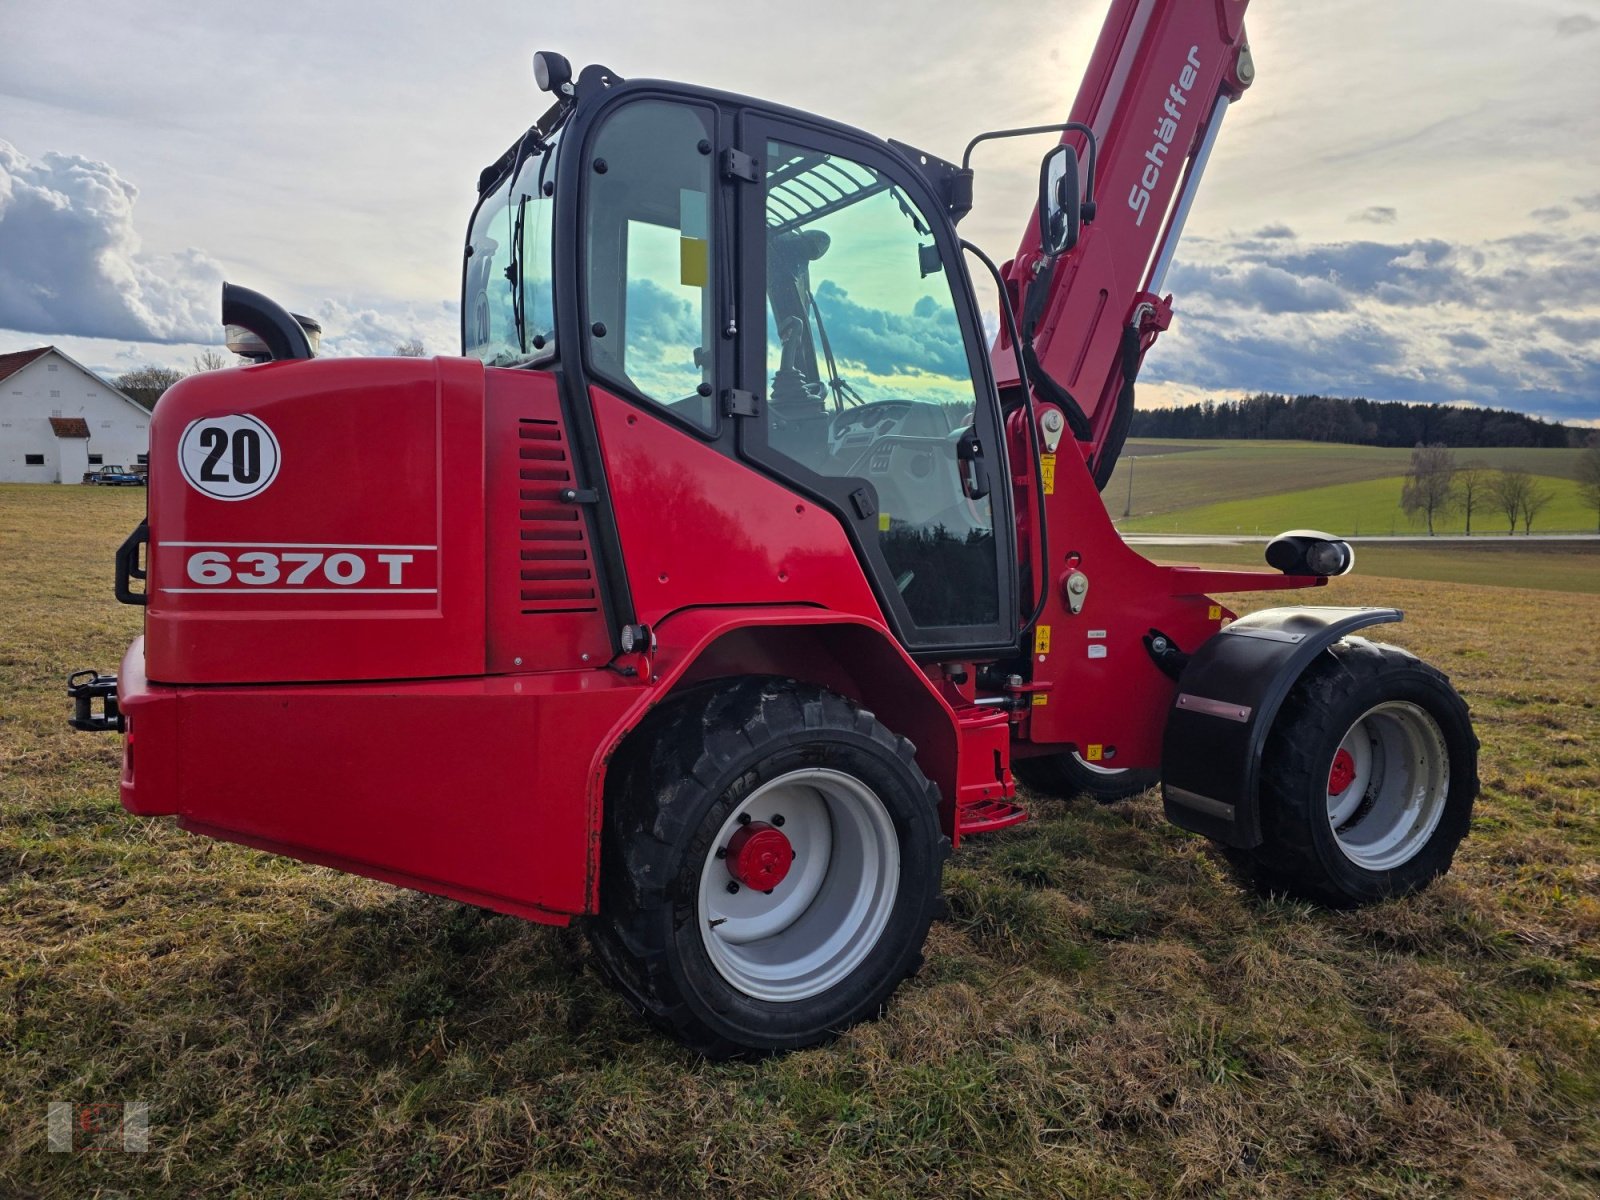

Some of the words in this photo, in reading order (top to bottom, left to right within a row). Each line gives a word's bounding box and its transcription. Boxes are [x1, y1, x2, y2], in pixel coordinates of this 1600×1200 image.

[1128, 45, 1201, 227] Schäffer
[200, 427, 261, 484] 20
[187, 551, 366, 585] 6370
[378, 554, 413, 585] T
